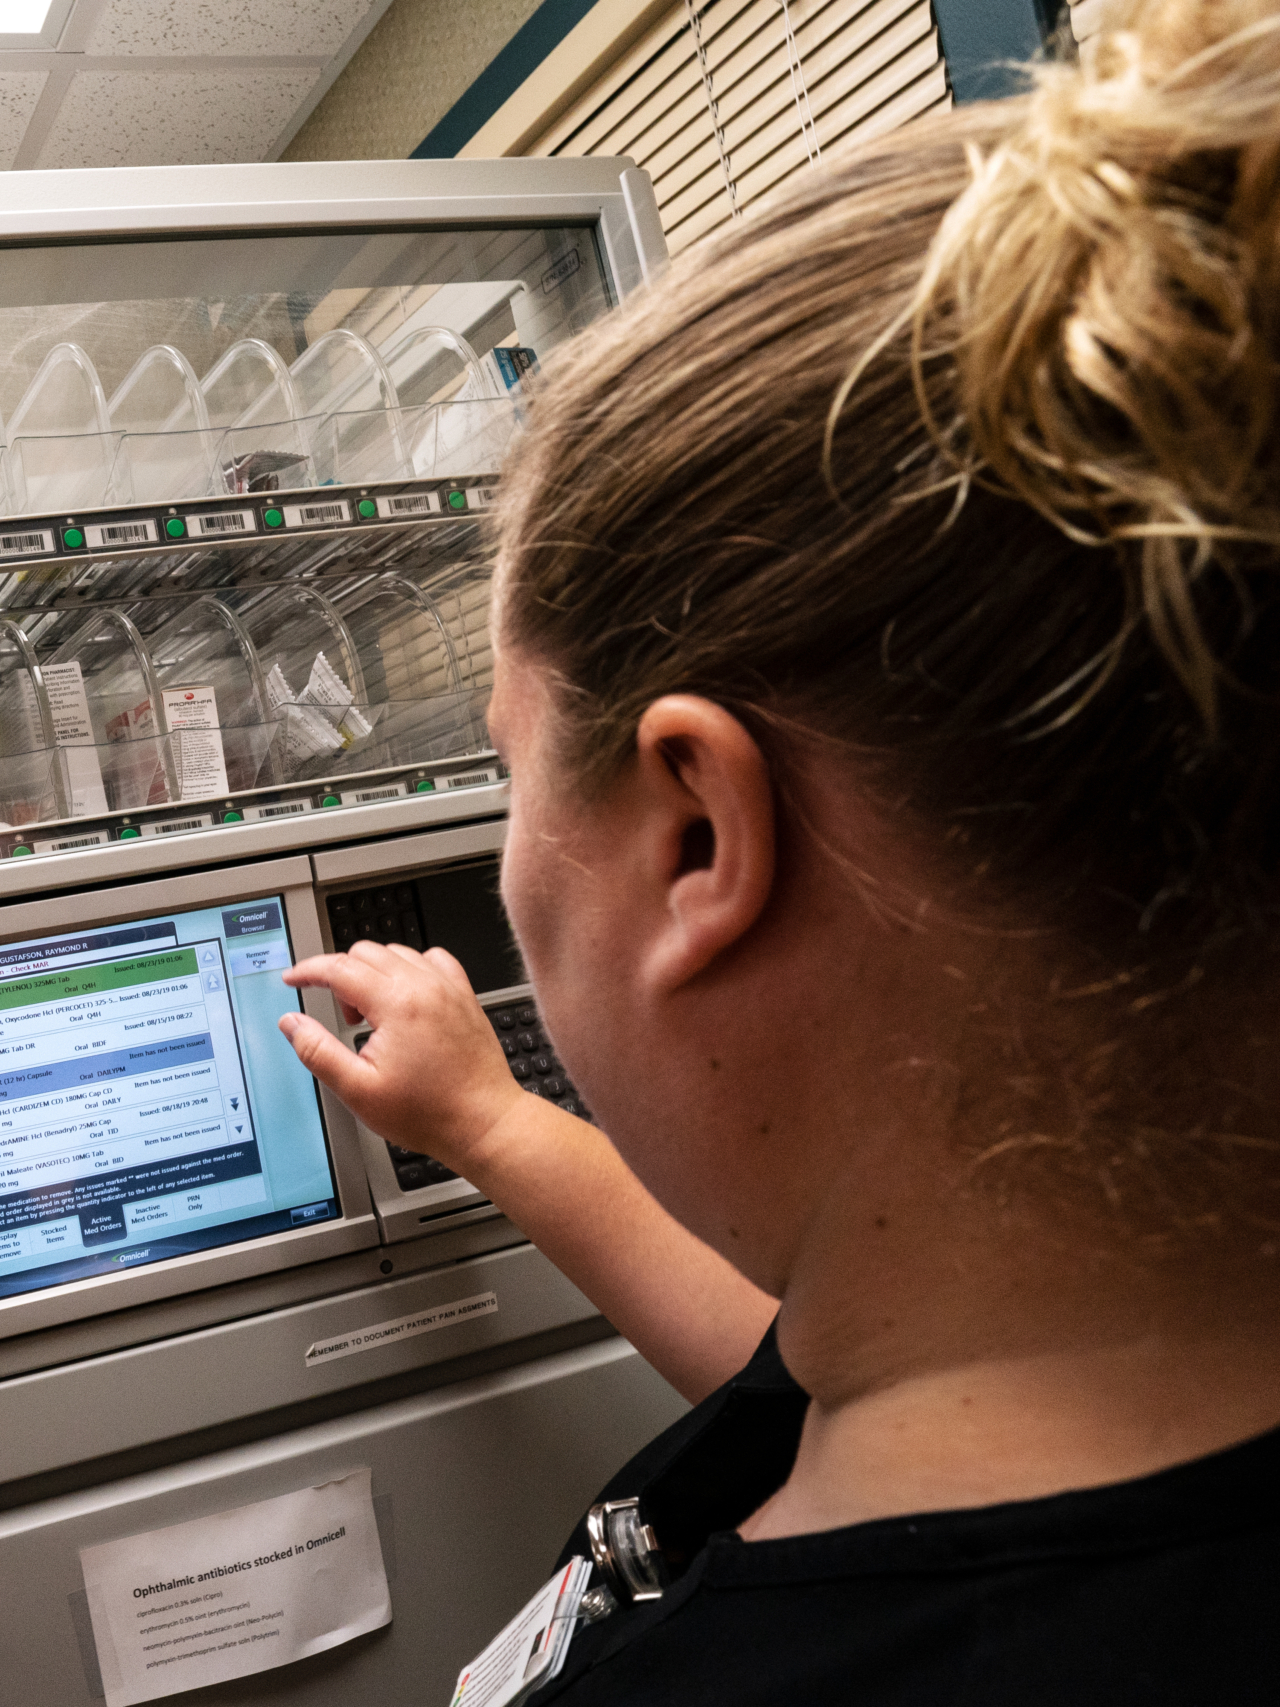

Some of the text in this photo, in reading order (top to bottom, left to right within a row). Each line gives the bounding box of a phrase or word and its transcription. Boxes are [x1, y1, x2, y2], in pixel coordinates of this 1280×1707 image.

[239, 911, 267, 923] Omnicell
[242, 925, 265, 933] Browser
[0, 951, 43, 964] GUSTAFSON,
[45, 944, 81, 955] RAYMOND
[11, 964, 31, 972] Check
[114, 955, 183, 973] Issued: 08/23/19 01:06
[34, 978, 56, 988] 325MG
[5, 1013, 41, 1023] Oxycodone
[55, 1002, 93, 1014] (PERCOCET)
[186, 1039, 205, 1048] issued
[4, 1077, 14, 1085] (12
[27, 1071, 52, 1080] Capsule
[12, 1101, 50, 1114] (CARDIZEM
[66, 1093, 87, 1102] 180MG
[44, 1126, 77, 1137] (Benadryl)
[80, 1121, 97, 1130] 25MG
[7, 1166, 33, 1175] Maleate
[35, 1157, 70, 1170] (VASOTEC)
[72, 1153, 90, 1161] 10MG
[6, 1208, 22, 1216] order
[24, 1201, 52, 1212] displayed
[61, 1197, 74, 1205] grey
[94, 1187, 121, 1196] available.
[135, 1205, 160, 1214] Inactive
[302, 1209, 317, 1219] Exit
[91, 1216, 111, 1224] Active
[131, 1212, 168, 1224] Med Orders
[41, 1225, 67, 1235] Stocked
[84, 1223, 122, 1235] Med Orders
[46, 1236, 64, 1244] Items
[119, 1249, 149, 1263] Omnicell
[364, 1325, 404, 1342] DOCUMENT
[407, 1316, 436, 1329] PATIENT
[439, 1311, 455, 1320] PAIN
[133, 1527, 345, 1598] Ophthalmic antibiotics stocked in Omnicell
[137, 1605, 174, 1618] ciprofloxacin
[174, 1600, 189, 1608] 0.3%
[203, 1591, 223, 1601] (Cipro)
[140, 1621, 179, 1634] erythromycin
[179, 1616, 194, 1624] 0.5%
[208, 1602, 250, 1618] (erythromycin)
[143, 1625, 232, 1651] neomycin-polymyxin-bacitracin
[246, 1610, 284, 1626] (Neo-Polycin)
[146, 1647, 216, 1669] polymyxin-trimethoprim
[217, 1642, 237, 1650] sulfate
[251, 1629, 280, 1642] (Polytrim)
